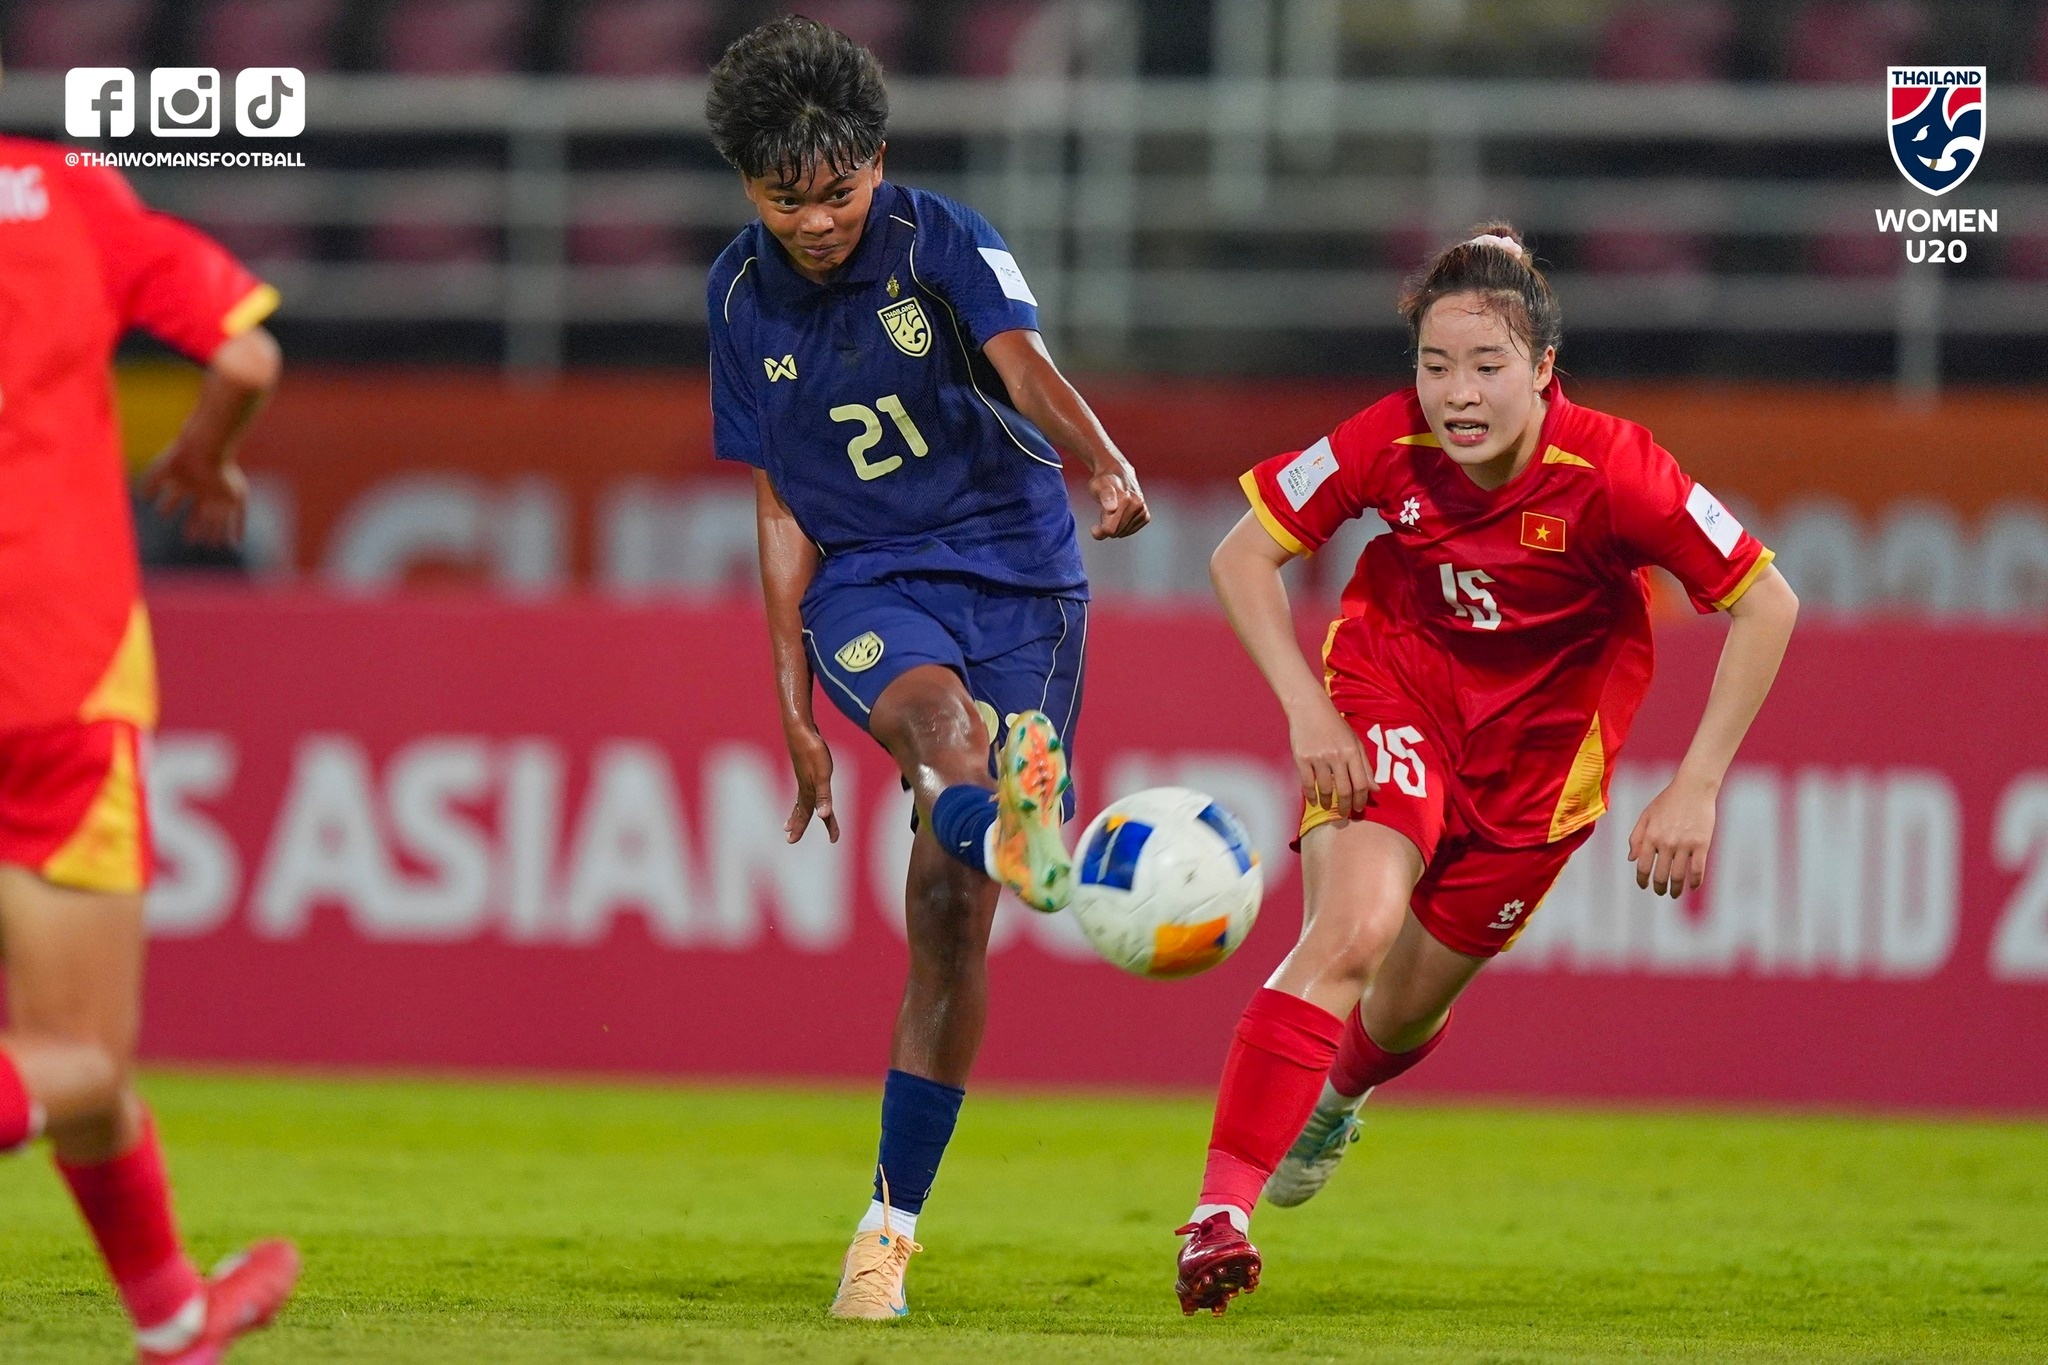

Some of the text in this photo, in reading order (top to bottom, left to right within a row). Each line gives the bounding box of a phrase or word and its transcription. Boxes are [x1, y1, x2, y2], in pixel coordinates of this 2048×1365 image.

[883, 303, 916, 320] THAILAND
[829, 394, 929, 481] 21
[1438, 562, 1502, 631] 15
[1366, 723, 1428, 799] 15
[252, 730, 852, 952] ASIAN
